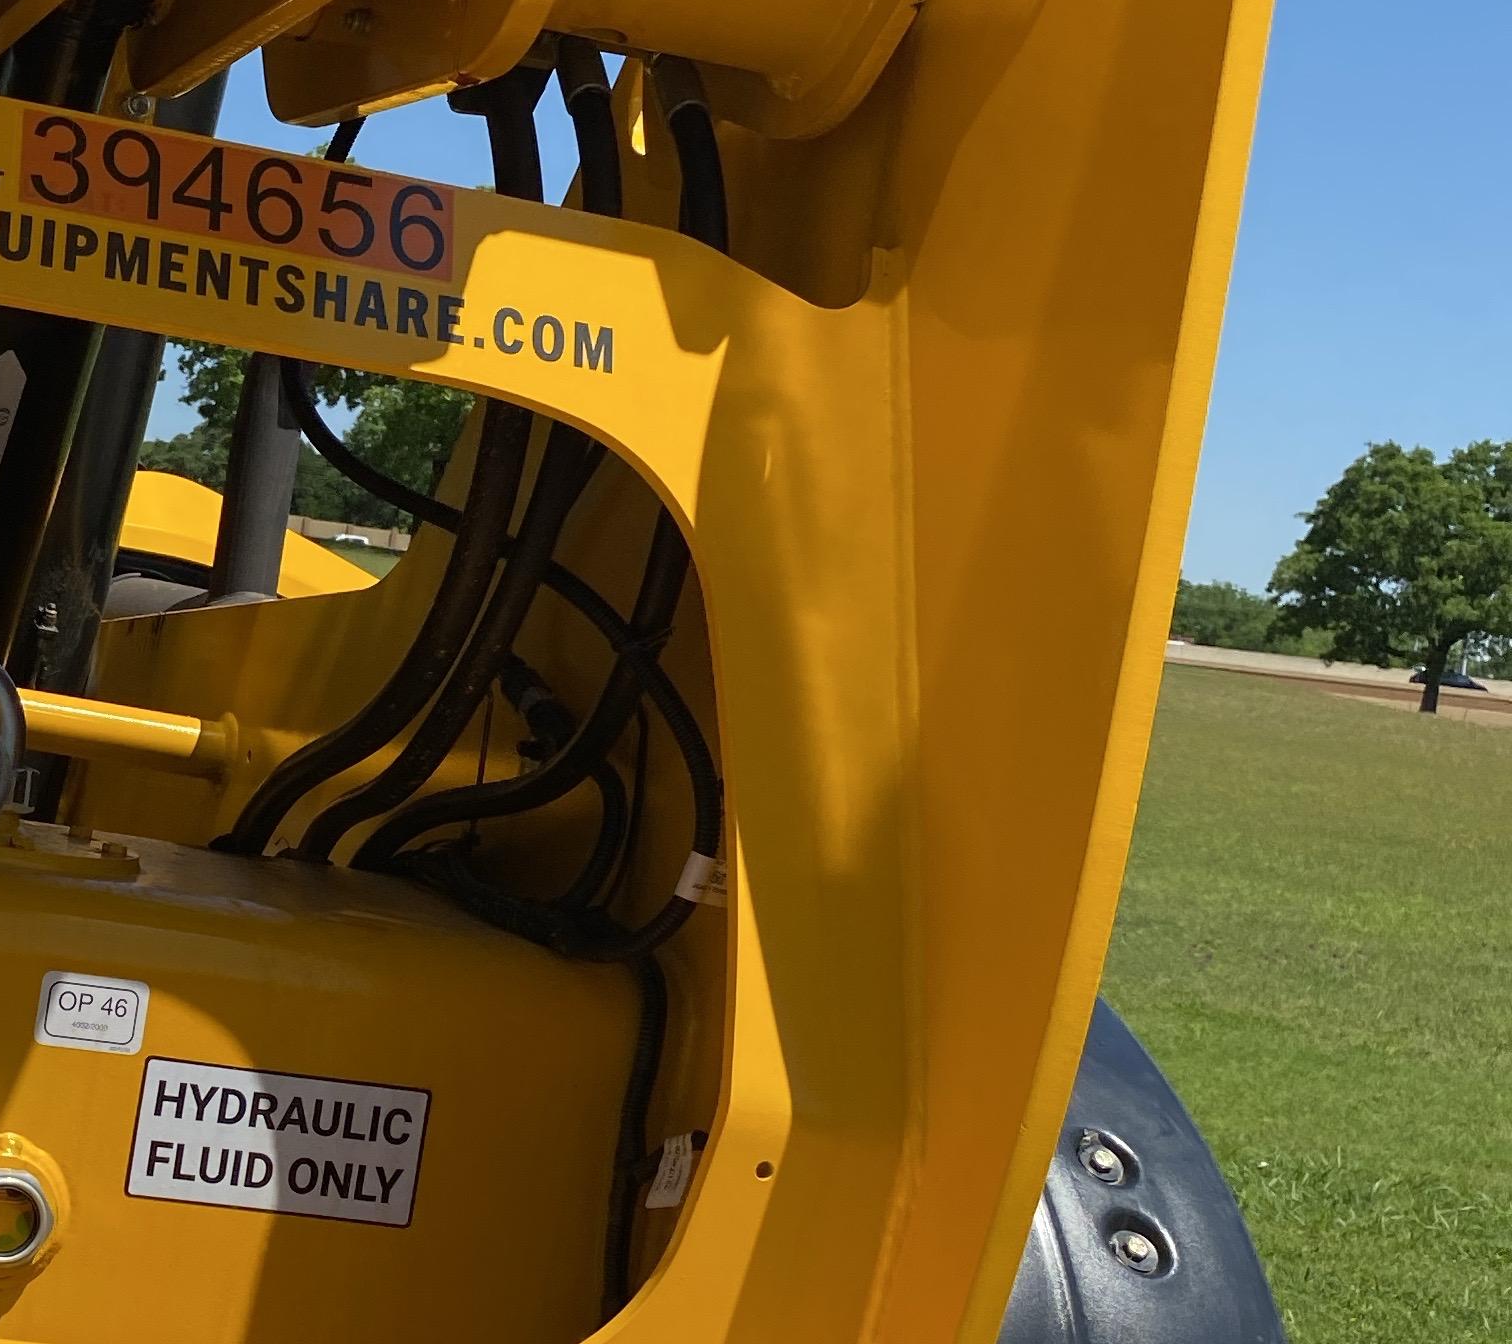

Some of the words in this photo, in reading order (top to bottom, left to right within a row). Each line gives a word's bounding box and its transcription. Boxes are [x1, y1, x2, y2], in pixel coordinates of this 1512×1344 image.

[29, 115, 446, 272] 394656
[59, 990, 94, 1012] OP
[100, 996, 128, 1018] 46
[153, 1079, 413, 1145] HYDRAULIC
[145, 1140, 274, 1188] FLUID
[288, 1156, 405, 1204] ONLY
